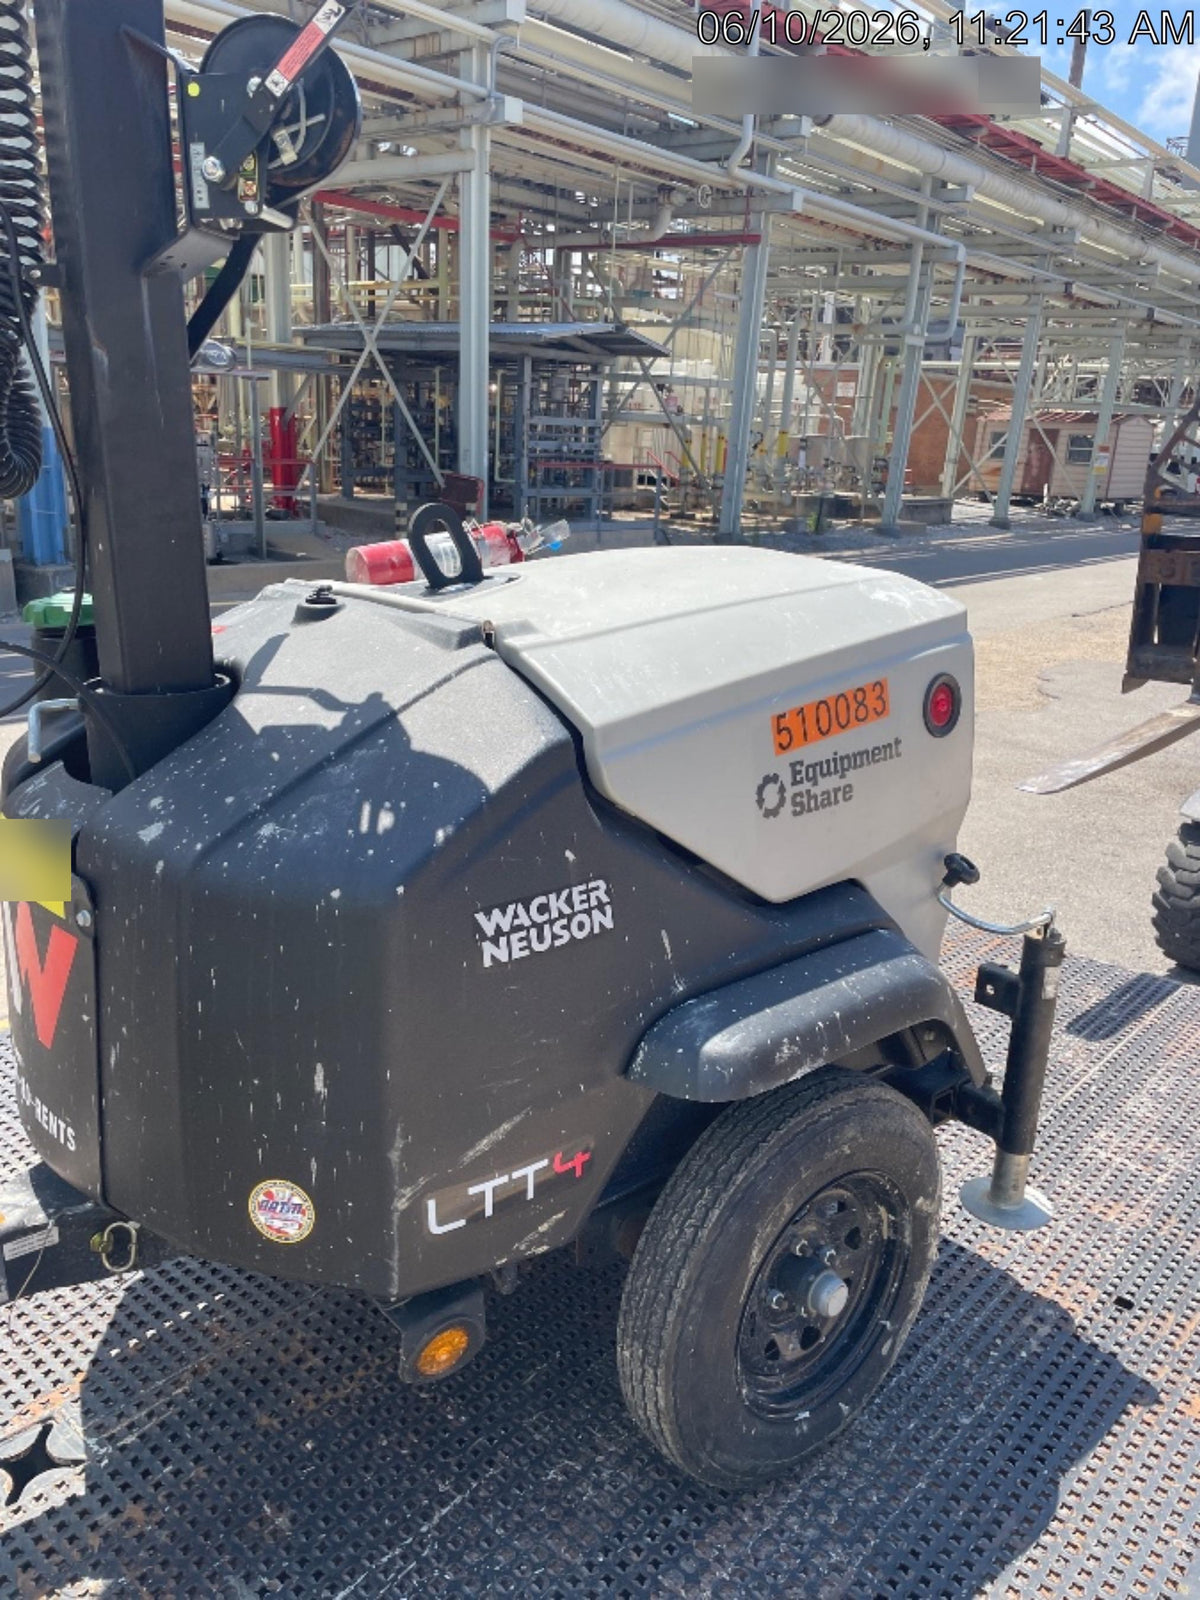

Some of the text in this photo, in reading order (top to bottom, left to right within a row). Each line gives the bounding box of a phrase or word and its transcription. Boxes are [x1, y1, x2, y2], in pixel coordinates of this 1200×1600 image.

[776, 681, 886, 751] 510083
[789, 737, 902, 787] Equipment
[790, 783, 853, 817] Share
[474, 879, 611, 938] WACKER
[481, 904, 615, 968] NEUSON
